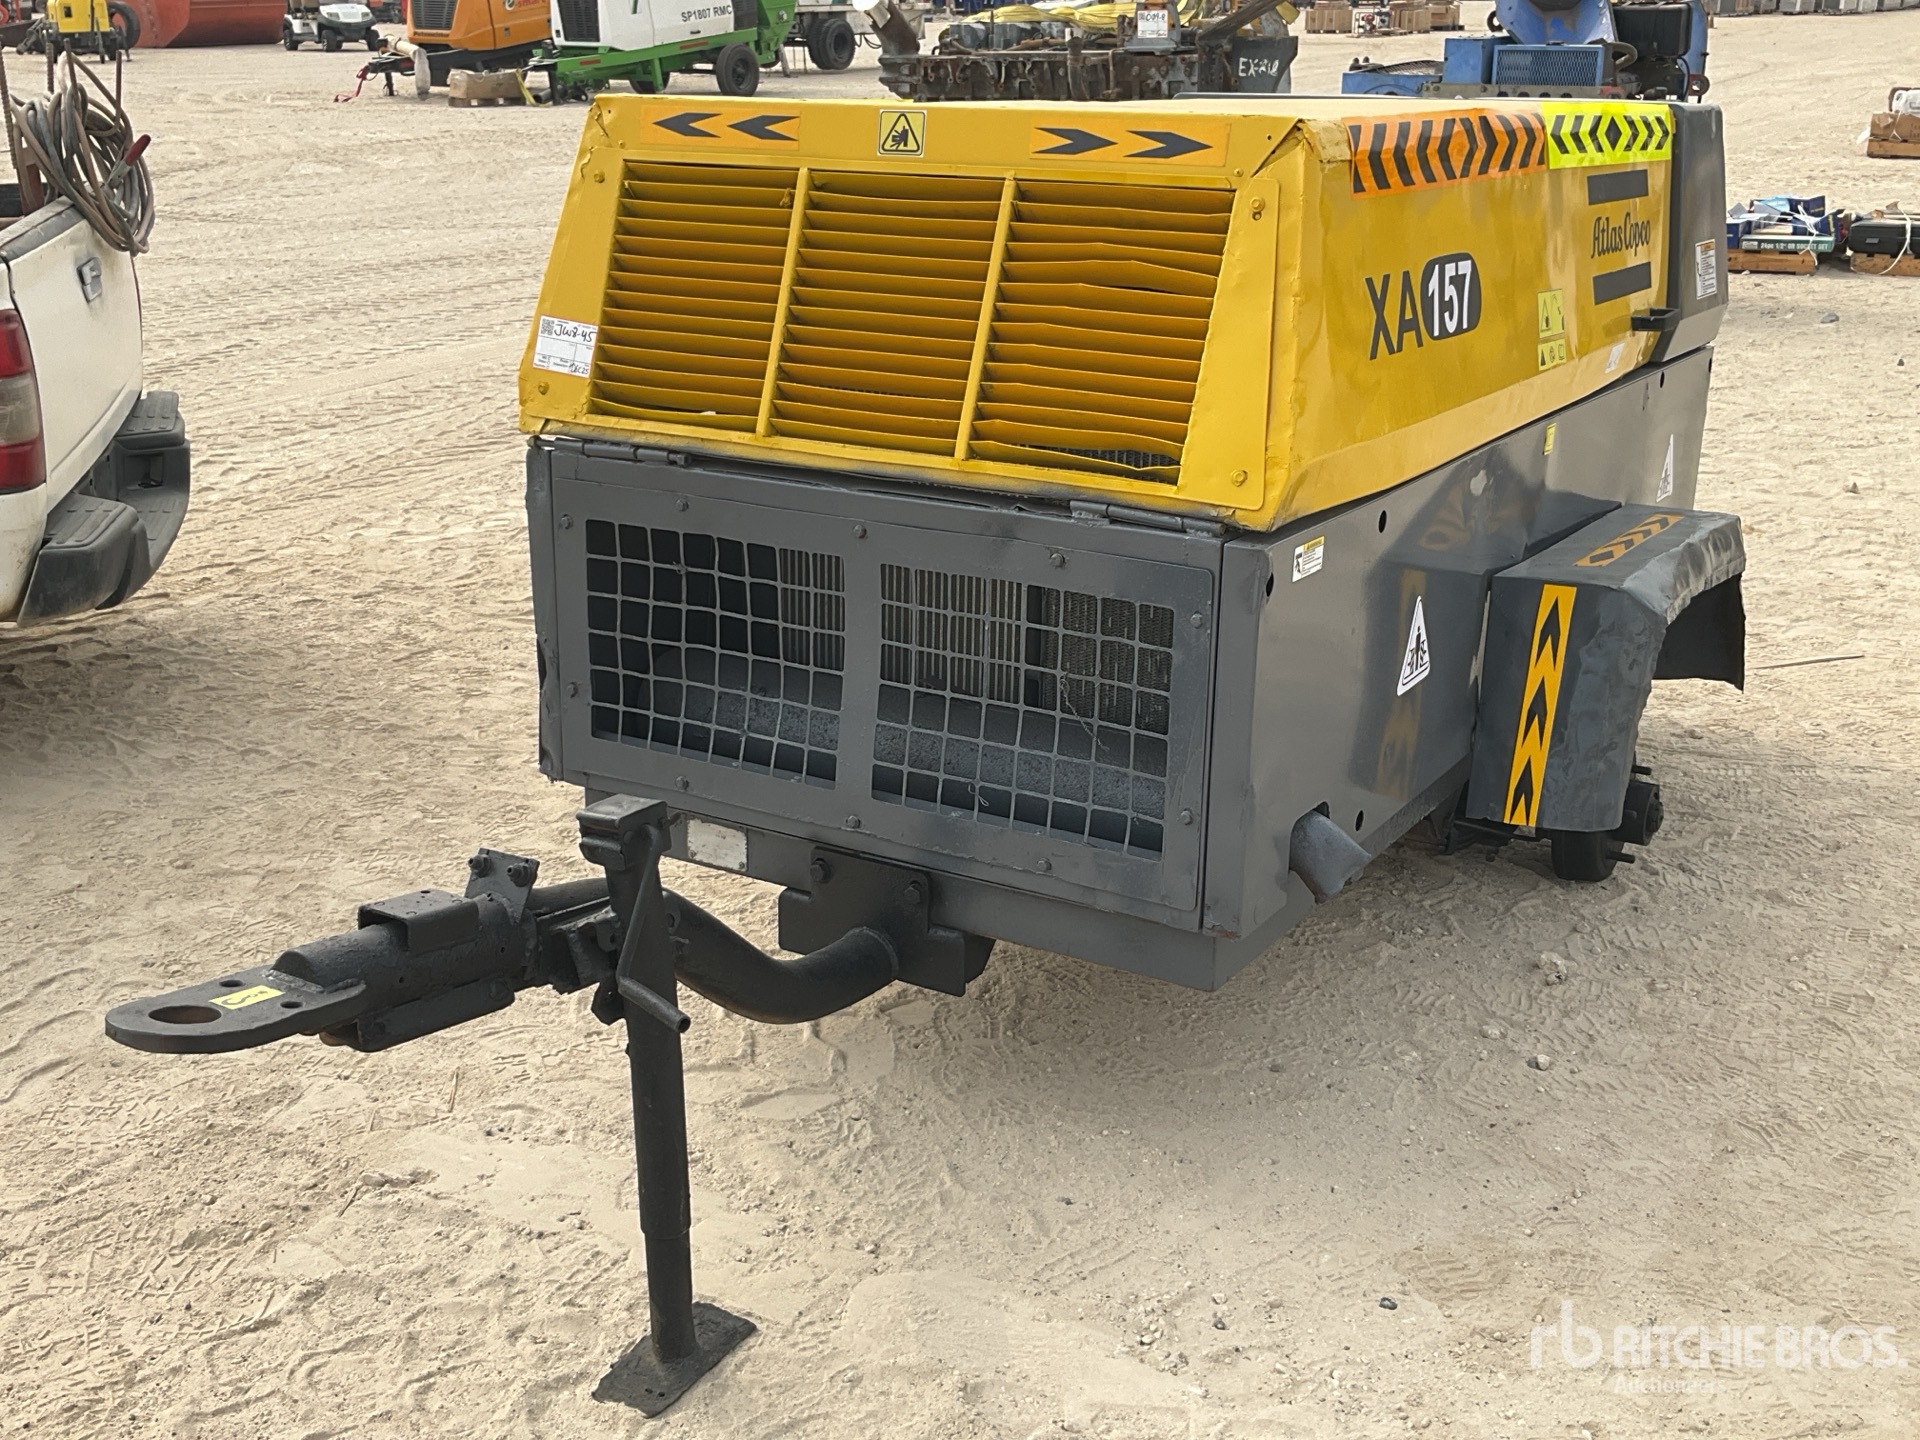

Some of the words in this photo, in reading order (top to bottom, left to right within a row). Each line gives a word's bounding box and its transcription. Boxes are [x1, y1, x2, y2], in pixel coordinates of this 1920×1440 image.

[681, 8, 711, 23] SP1807
[712, 5, 733, 17] RMC
[1591, 216, 1623, 259] Atlas
[1623, 211, 1651, 257] Copco
[1428, 259, 1472, 337] 157
